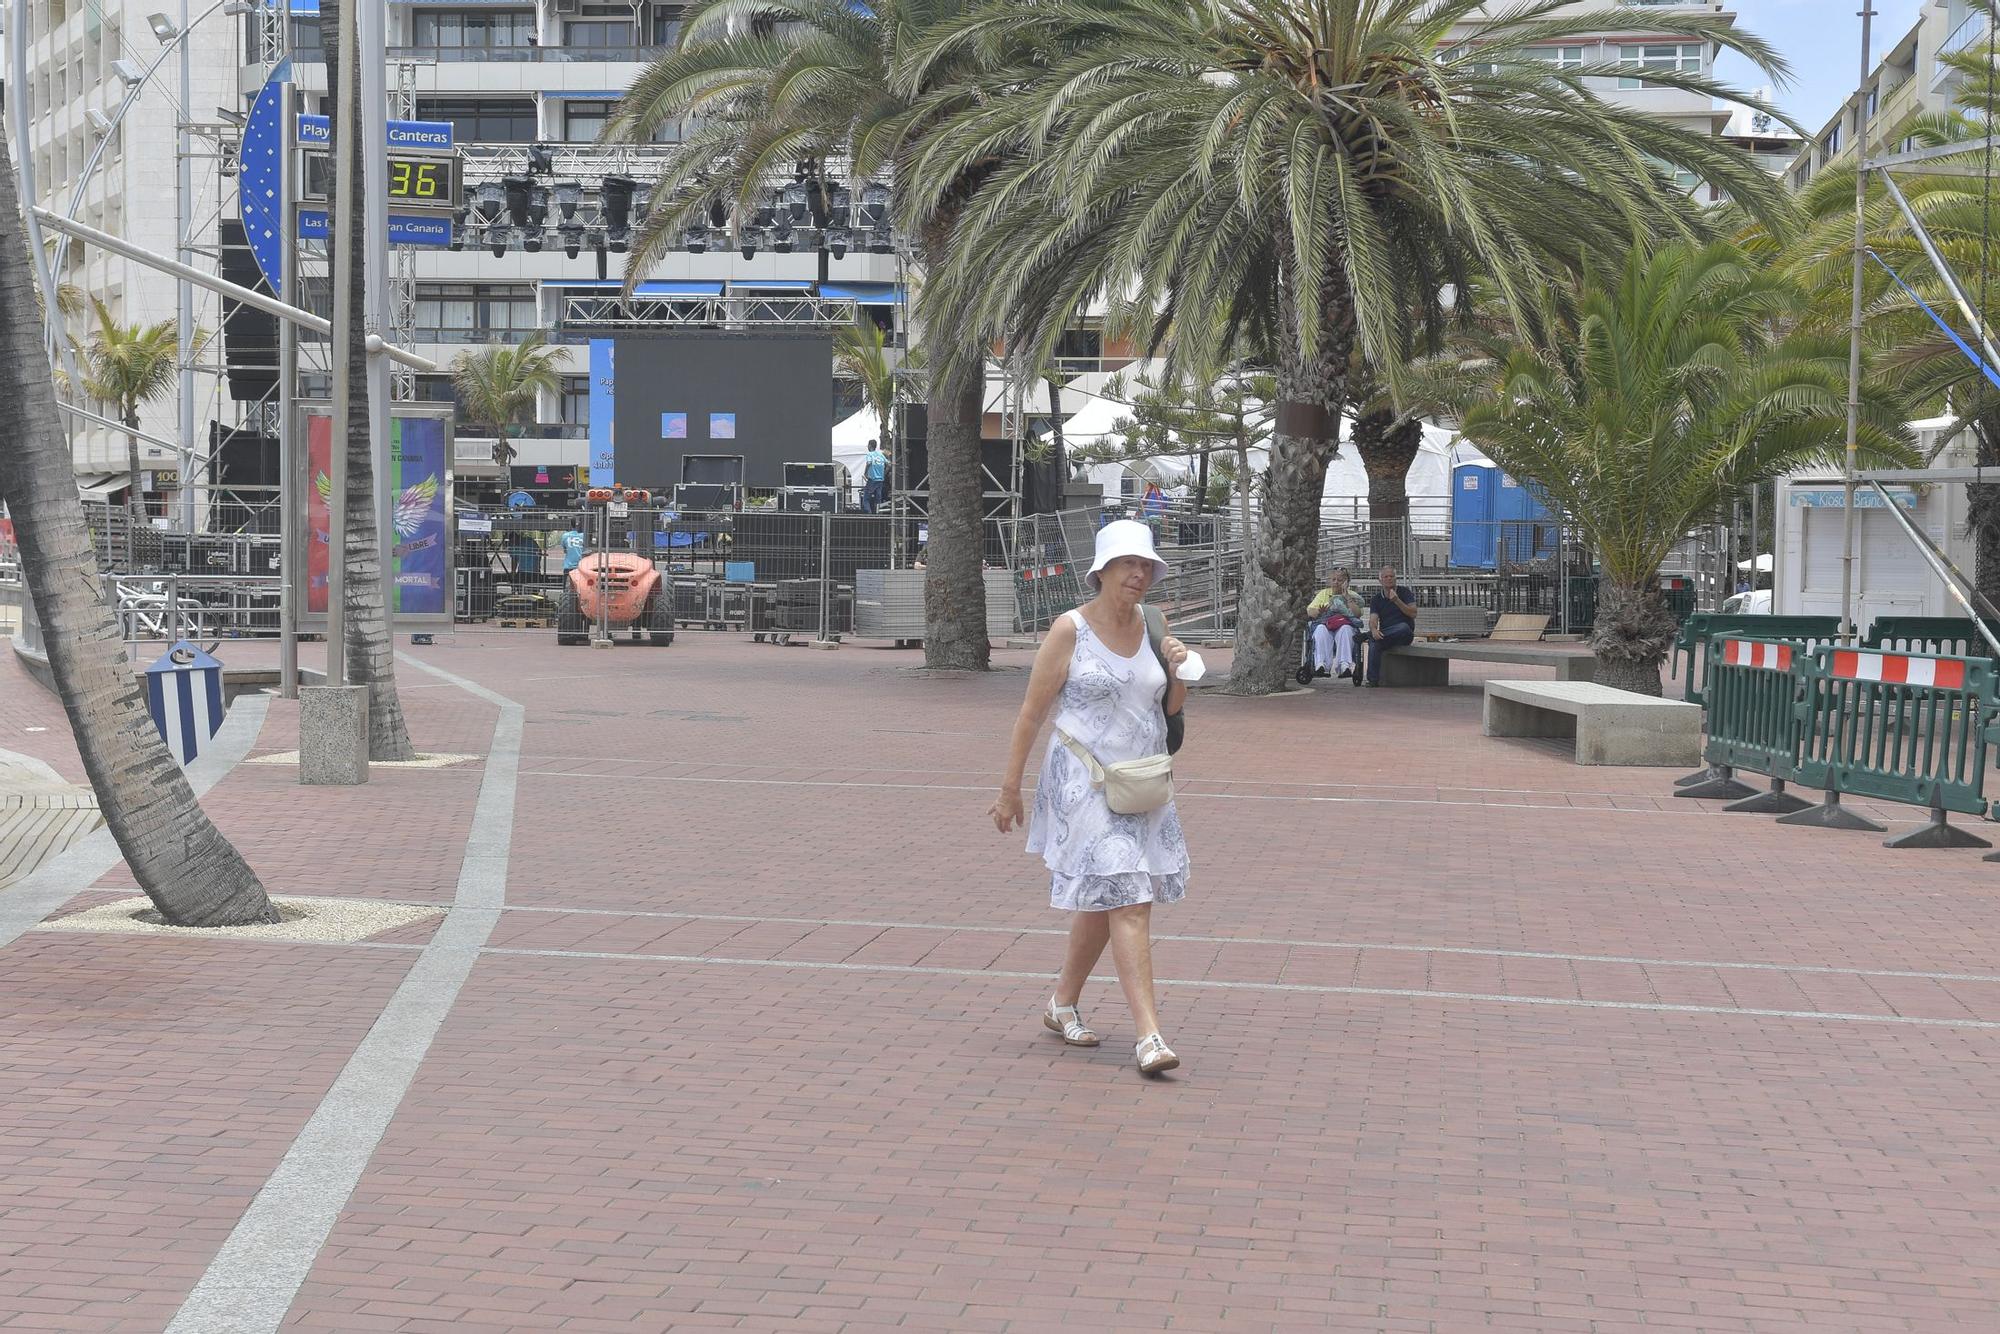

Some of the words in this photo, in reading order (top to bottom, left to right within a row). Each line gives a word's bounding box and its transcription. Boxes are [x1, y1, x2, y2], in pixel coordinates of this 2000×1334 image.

[303, 124, 330, 140] Play
[389, 129, 448, 143] Canteras
[390, 163, 437, 196] 36
[305, 217, 322, 227] Las
[387, 223, 403, 232] ran
[405, 222, 444, 234] Canaria
[408, 540, 429, 551] LIBRE
[394, 576, 428, 584] MORTAL
